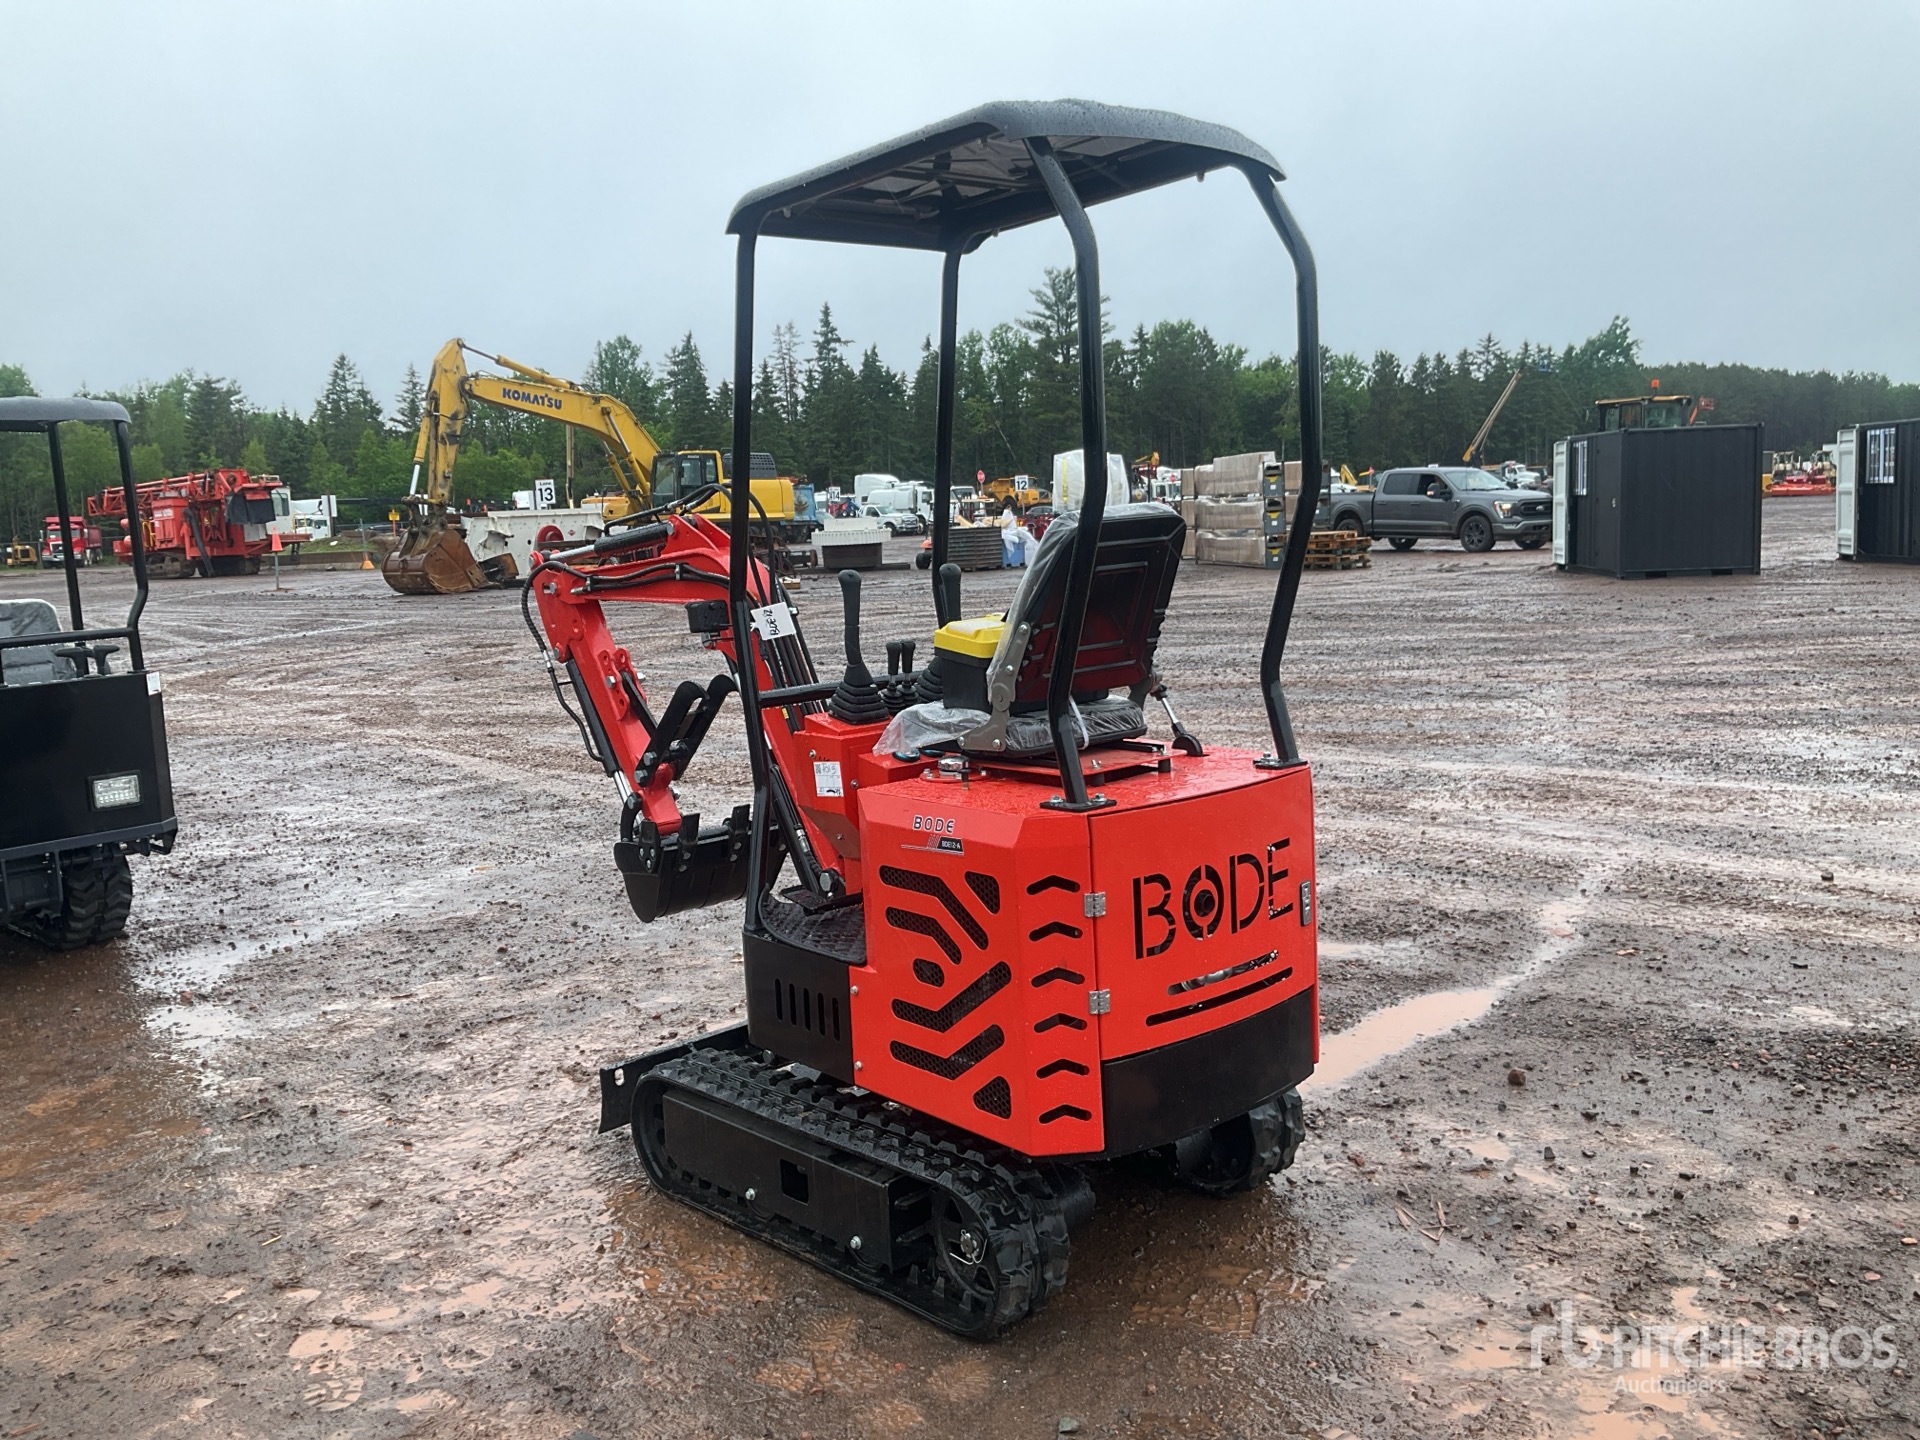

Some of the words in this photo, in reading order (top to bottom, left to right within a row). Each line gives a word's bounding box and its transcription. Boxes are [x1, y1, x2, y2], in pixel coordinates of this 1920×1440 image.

[502, 387, 562, 410] KOMATSU
[538, 487, 553, 502] 13
[1016, 480, 1027, 491] 12
[912, 815, 955, 834] BODE
[1132, 837, 1293, 960] BODE
